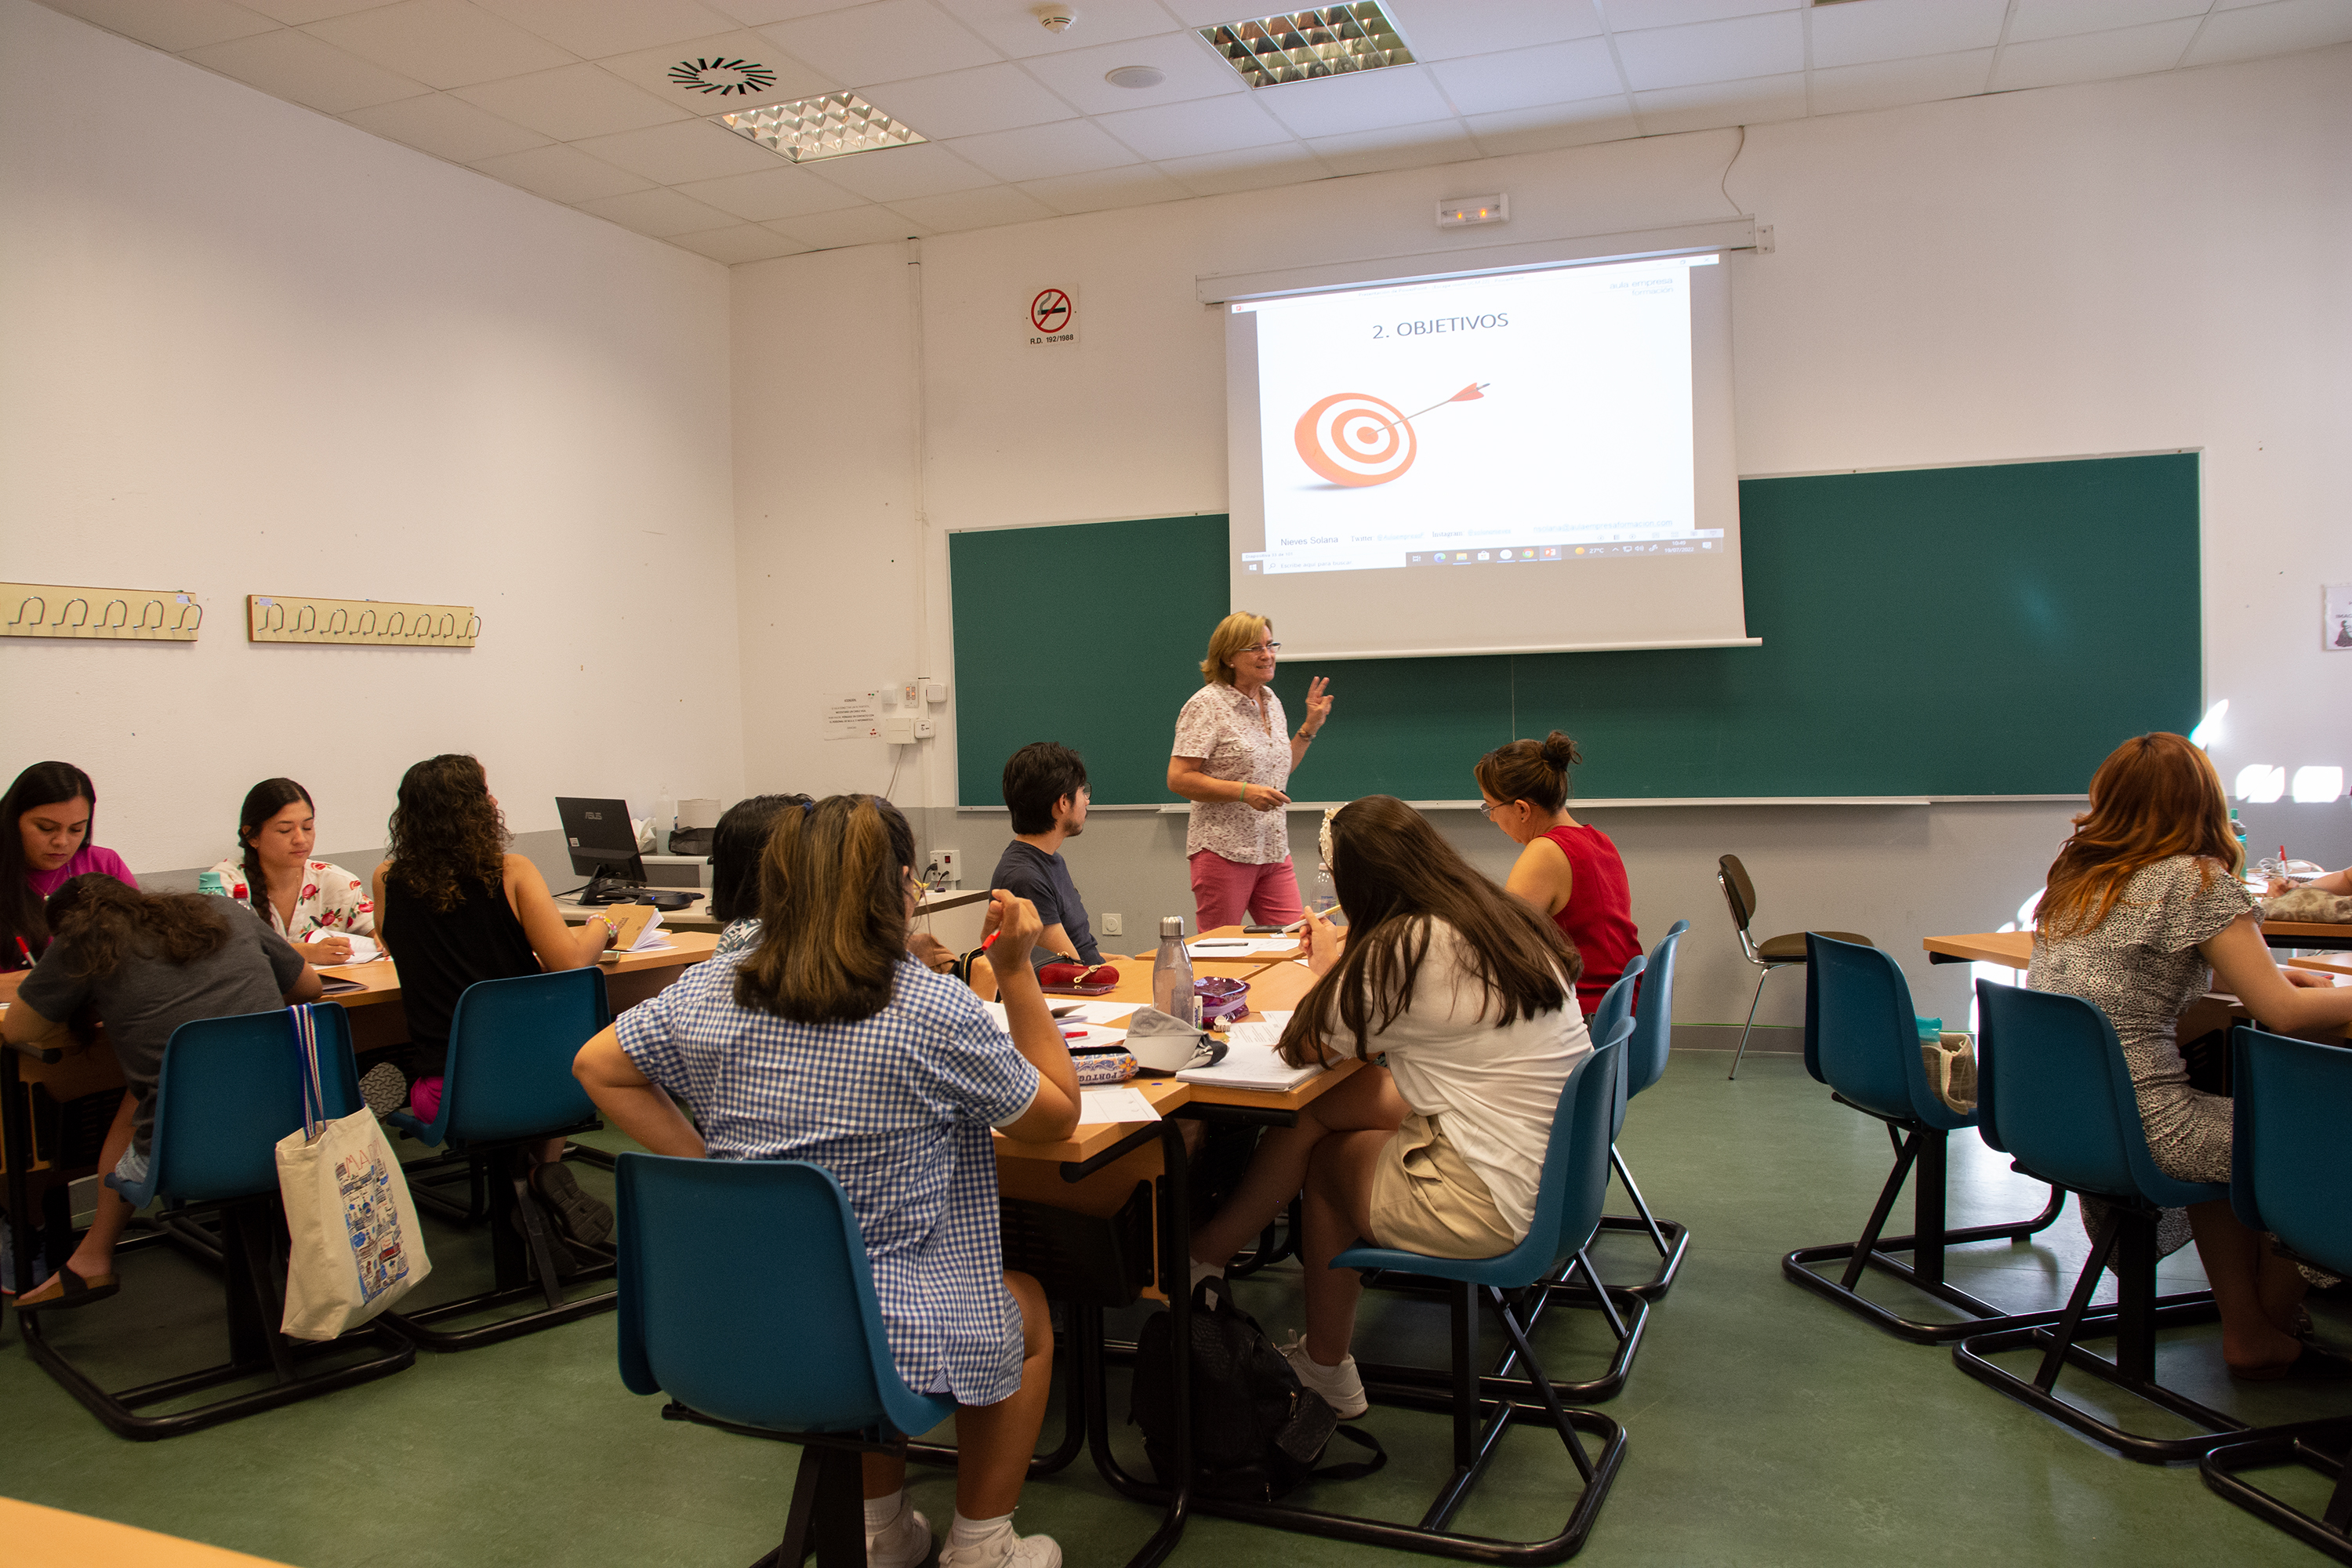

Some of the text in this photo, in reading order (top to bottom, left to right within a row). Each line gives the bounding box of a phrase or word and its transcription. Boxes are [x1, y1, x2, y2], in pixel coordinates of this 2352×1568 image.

[1632, 278, 1673, 287] empresa
[1632, 286, 1674, 296] formación
[1373, 313, 1509, 339] 2. OBJETIVOS
[1046, 334, 1074, 343] 192/1988
[585, 811, 602, 820] ASUS
[1078, 1072, 1118, 1082] PORTUG
